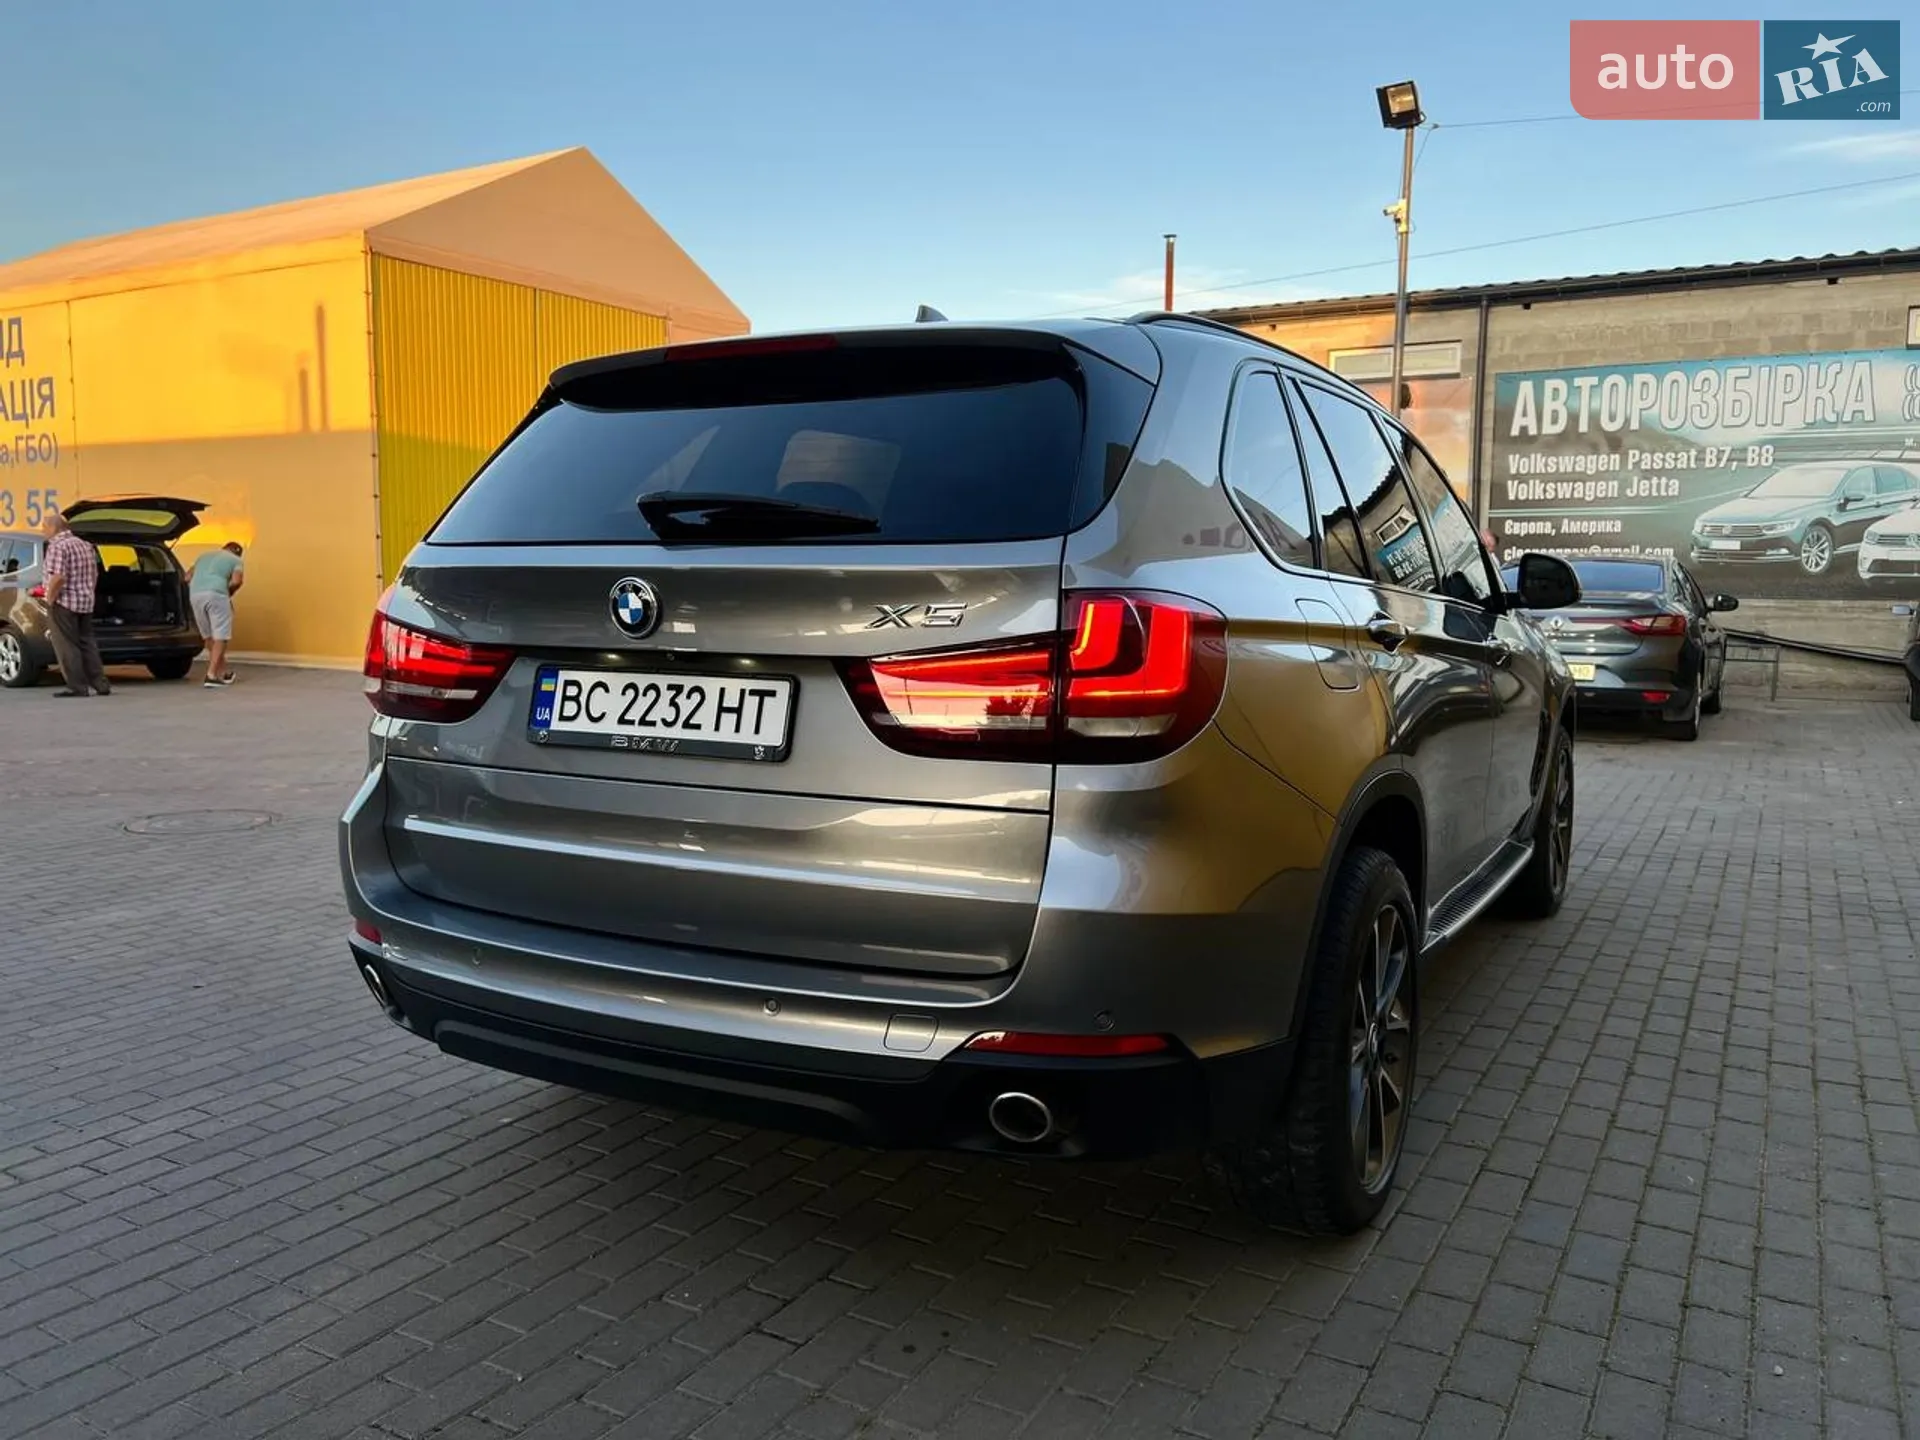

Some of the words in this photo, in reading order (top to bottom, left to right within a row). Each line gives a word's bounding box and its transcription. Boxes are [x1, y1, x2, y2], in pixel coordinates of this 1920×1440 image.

[0, 316, 25, 369] Д
[1508, 359, 1877, 437] АВТОРОЗБІРКА
[1508, 453, 1621, 475] Volkswagen
[1627, 449, 1698, 471] Passat
[1704, 446, 1738, 471] B7,
[1746, 444, 1775, 467] B8
[1507, 478, 1619, 501] Volkswagen
[1626, 476, 1680, 498] Jetta
[1504, 518, 1556, 537] Європа,
[1560, 517, 1622, 536] Америка
[865, 604, 968, 629] X5
[536, 707, 550, 721] UA
[558, 679, 611, 724] BC
[617, 681, 707, 731] 2232
[714, 686, 777, 735] HT
